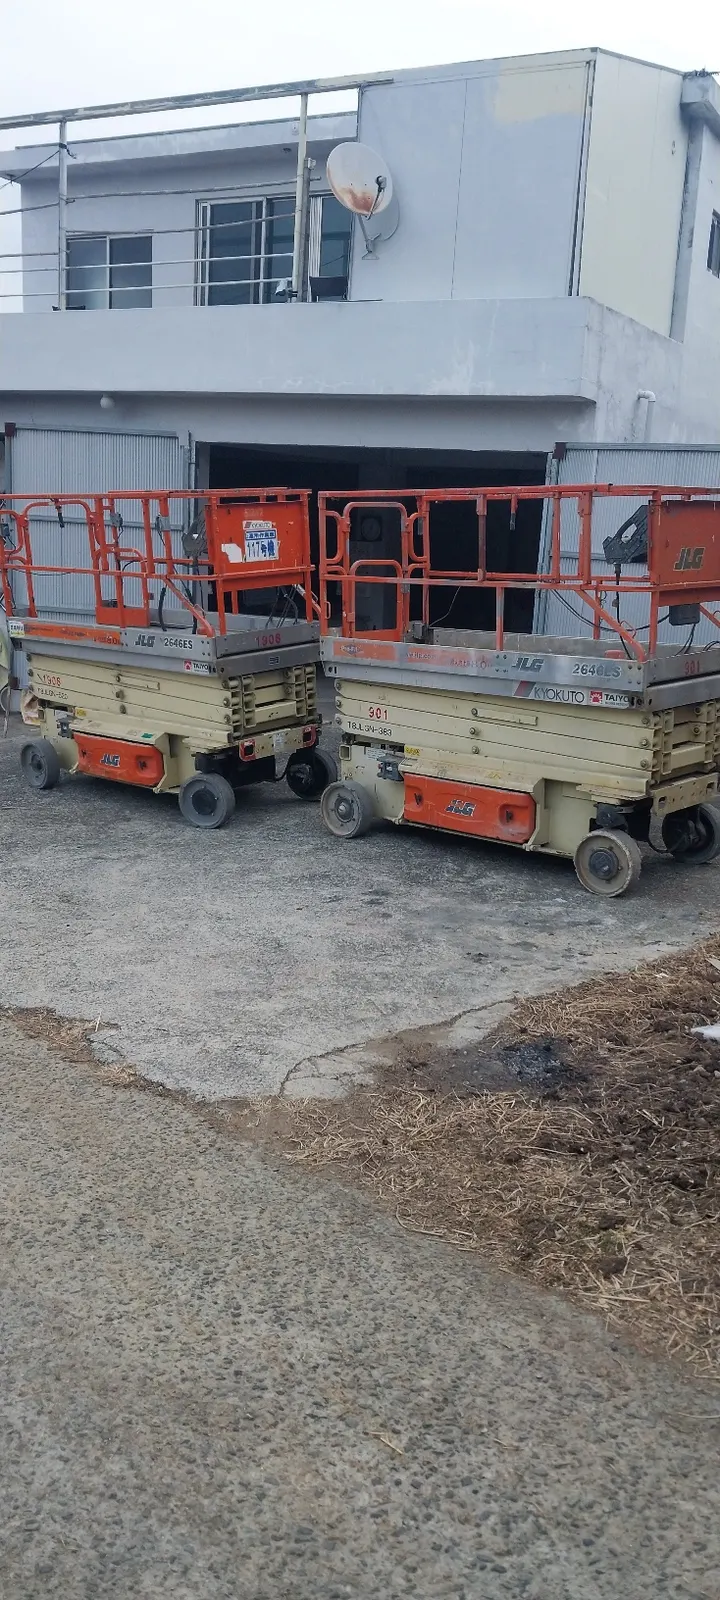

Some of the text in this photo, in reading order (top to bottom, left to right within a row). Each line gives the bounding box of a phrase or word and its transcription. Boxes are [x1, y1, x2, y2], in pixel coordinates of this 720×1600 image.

[673, 547, 706, 571] JLG
[135, 634, 155, 648] JLG
[164, 638, 193, 650] 2646ES
[511, 657, 544, 673] JLG
[534, 687, 585, 704] KYOKUTO
[368, 706, 388, 720] 901
[100, 753, 121, 768] JLG
